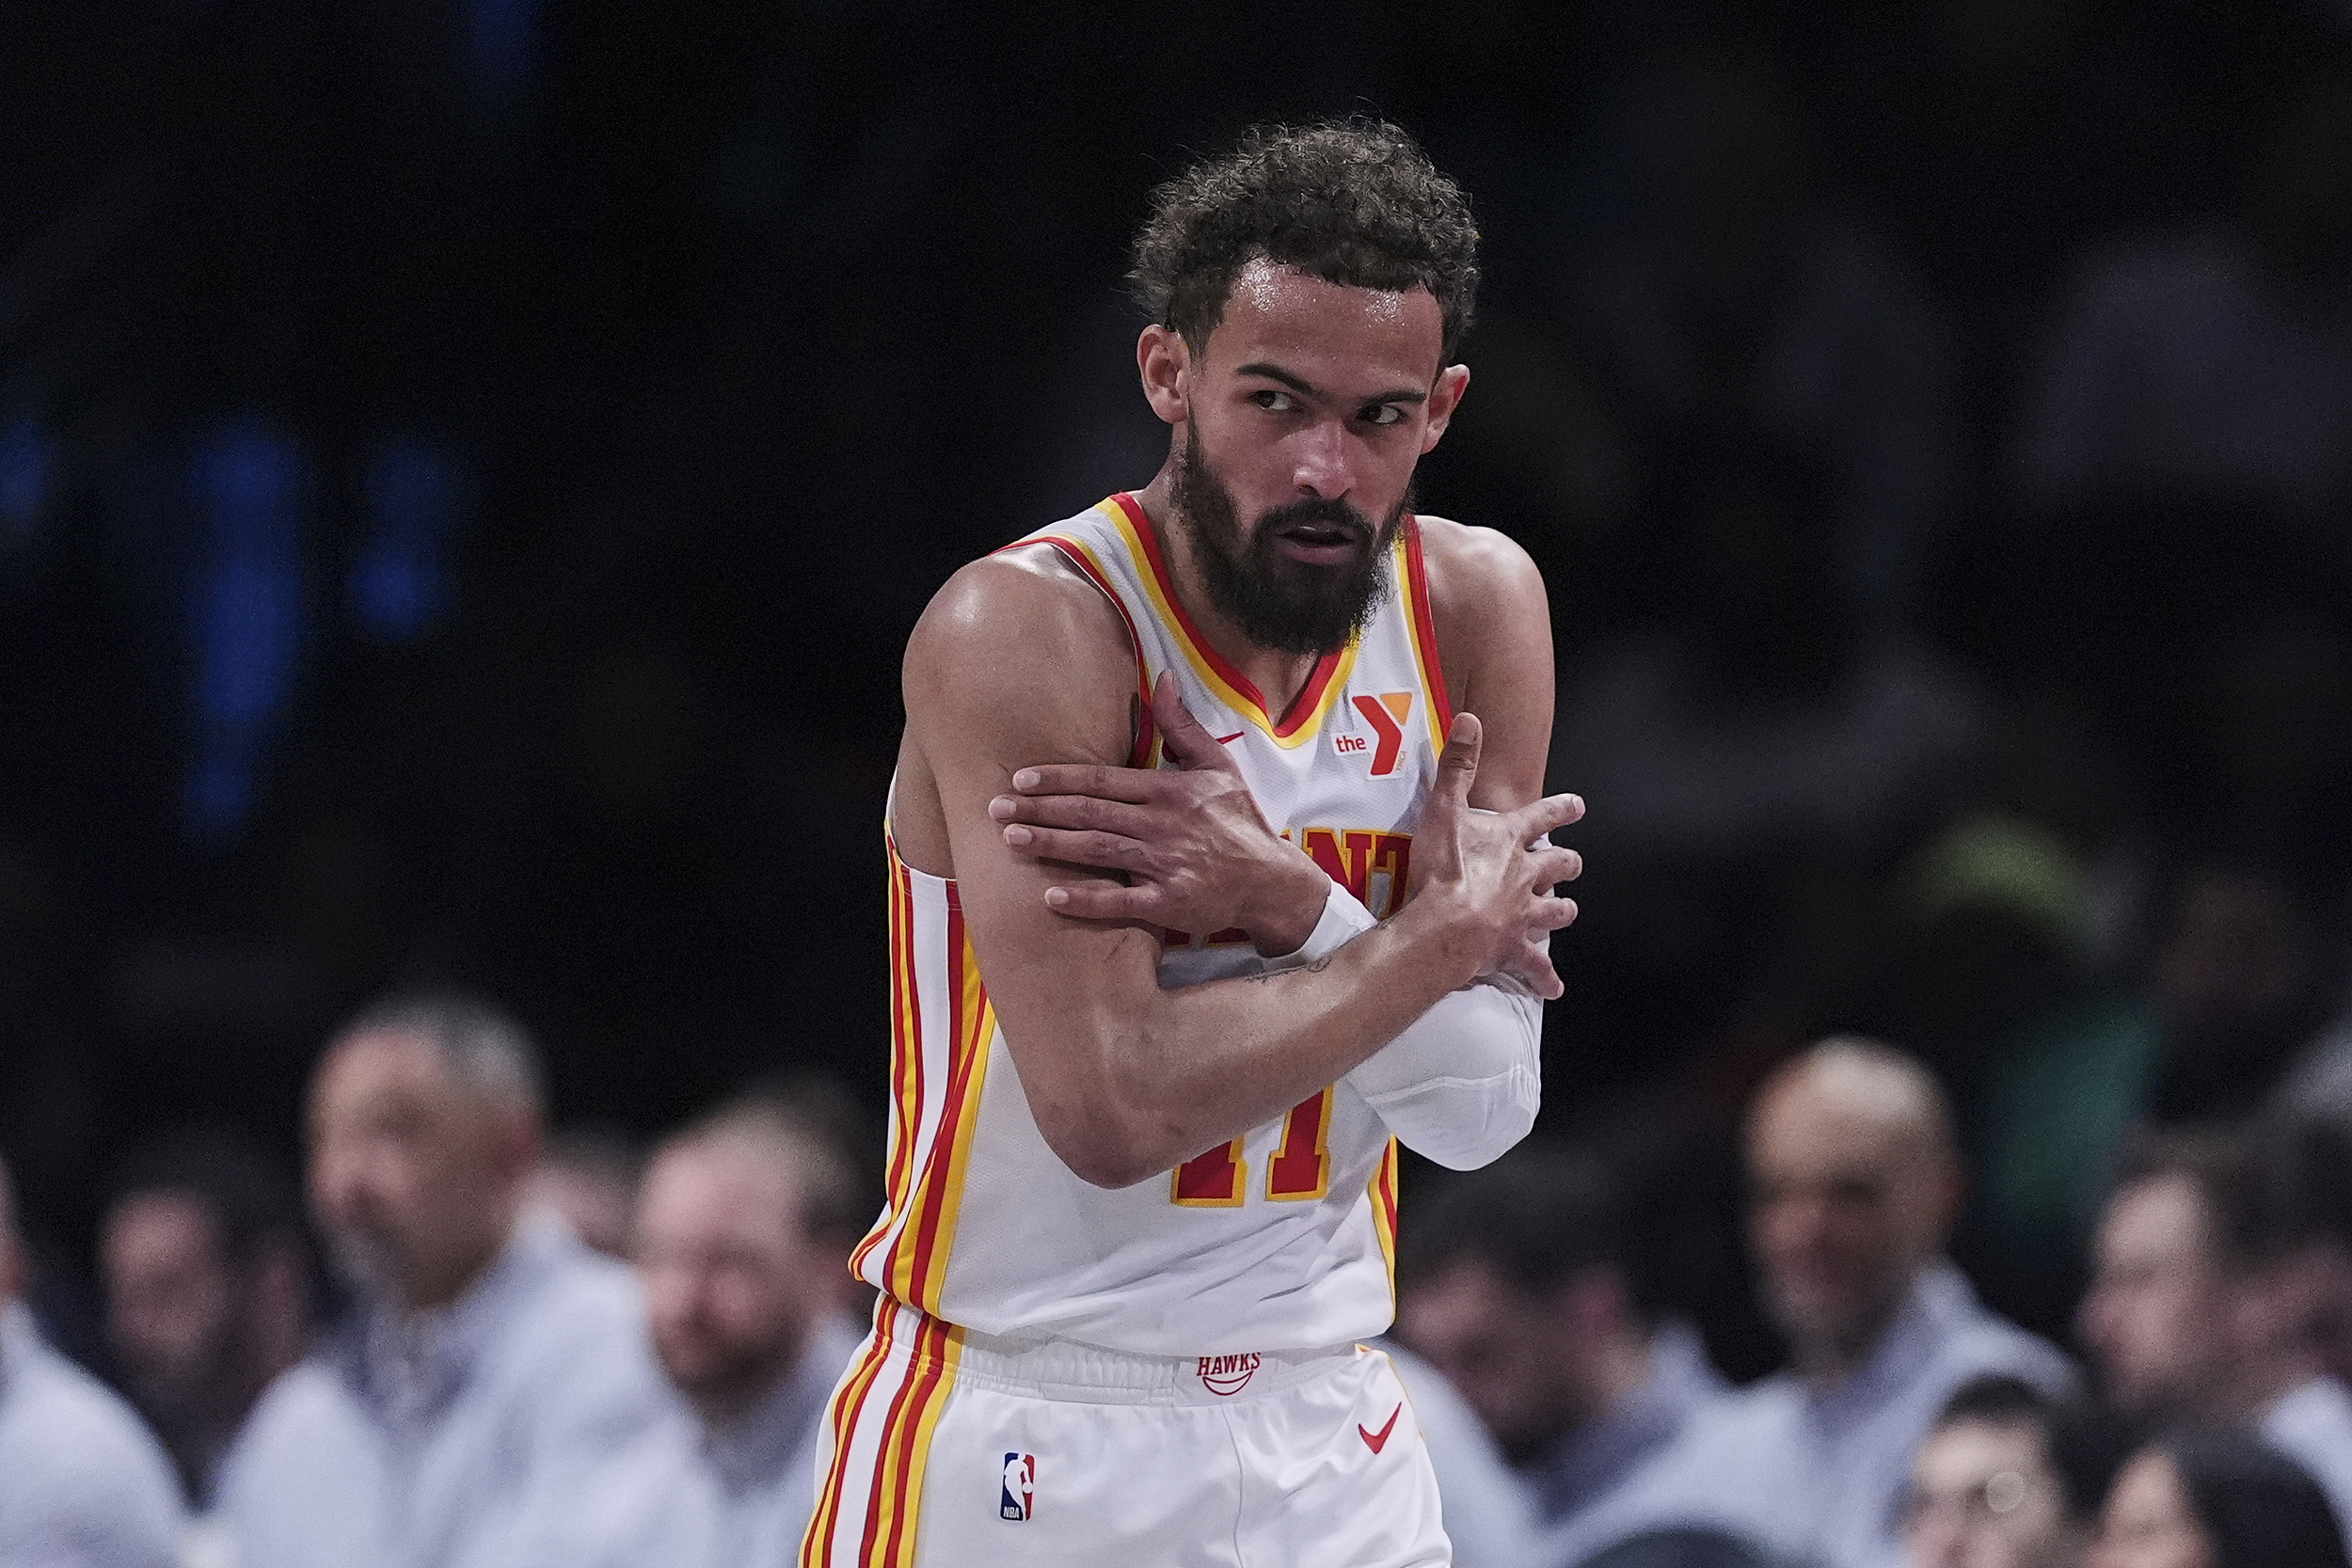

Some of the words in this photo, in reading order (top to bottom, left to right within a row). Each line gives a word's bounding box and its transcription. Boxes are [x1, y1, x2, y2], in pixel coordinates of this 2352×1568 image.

[1336, 735, 1366, 752] the
[1196, 1352, 1262, 1376] HAWKS
[1003, 1506, 1020, 1519] NBA
